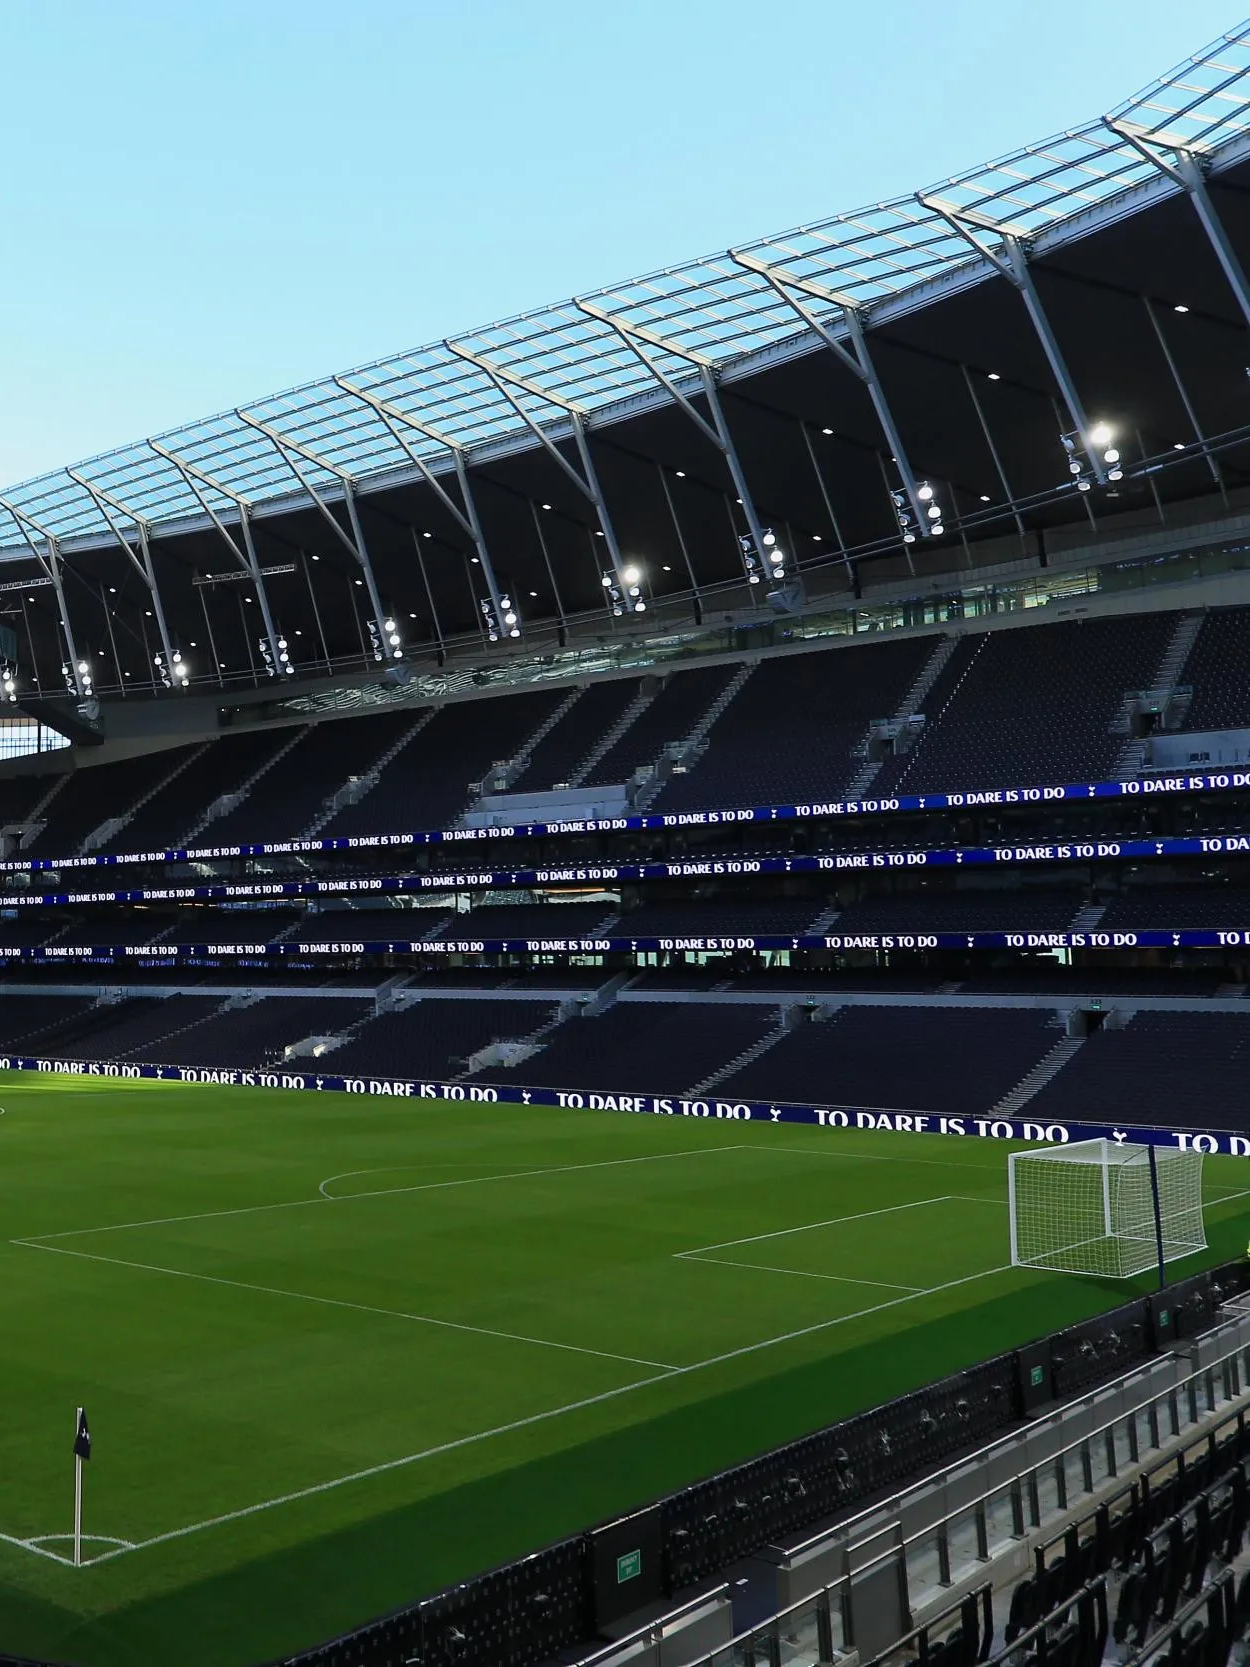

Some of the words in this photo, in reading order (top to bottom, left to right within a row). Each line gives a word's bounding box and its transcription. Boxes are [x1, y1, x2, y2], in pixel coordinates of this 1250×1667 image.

[1119, 781, 1140, 794] TO
[1143, 778, 1186, 793] DARE
[1189, 776, 1204, 790] IS
[1207, 774, 1229, 788] TO
[947, 794, 964, 805] TO
[966, 791, 1003, 804] DARE
[1005, 790, 1019, 802] IS
[1021, 789, 1041, 801] TO
[1043, 787, 1065, 799] DO
[795, 805, 811, 816] TO
[812, 803, 845, 815] DARE
[846, 802, 859, 813] IS
[860, 800, 878, 812] TO
[880, 799, 899, 810] DO
[546, 823, 559, 833] TO
[559, 821, 585, 833] DARE
[586, 821, 596, 831] IS
[597, 820, 611, 830] TO
[612, 819, 628, 829] DO
[263, 844, 273, 853] TO
[273, 843, 292, 852] DARE
[292, 842, 301, 851] IS
[300, 841, 311, 850] TO
[311, 841, 323, 850] DO
[994, 849, 1013, 860] TO
[1015, 847, 1054, 860] DARE
[1057, 846, 1071, 858] IS
[1074, 845, 1095, 857] TO
[1097, 844, 1121, 856] DO
[1199, 839, 1222, 852] TO
[818, 857, 834, 869] TO
[836, 855, 870, 868] DARE
[872, 855, 885, 866] IS
[887, 854, 905, 865] TO
[907, 853, 927, 865] DO
[536, 871, 549, 881] TO
[549, 870, 576, 881] DARE
[576, 869, 587, 880] IS
[587, 869, 601, 879] TO
[602, 868, 618, 878] DO
[143, 890, 152, 899] TO
[151, 890, 169, 899] DARE
[168, 889, 176, 898] IS
[175, 889, 185, 898] TO
[184, 889, 195, 897] DO
[825, 937, 842, 948] TO
[843, 936, 879, 948] DARE
[881, 936, 894, 947] IS
[896, 936, 915, 947] TO
[917, 936, 938, 947] DO
[1005, 934, 1025, 946] TO
[1027, 934, 1068, 946] DARE
[1071, 934, 1086, 946] IS
[1088, 933, 1110, 946] TO
[1113, 933, 1137, 946] DO
[1216, 931, 1240, 945] TO
[36, 1060, 52, 1073] TO
[54, 1061, 86, 1075] DARE
[88, 1063, 100, 1076] IS
[102, 1064, 119, 1077] TO
[121, 1065, 141, 1078] DO
[179, 1069, 198, 1083] TO
[200, 1070, 238, 1085] DARE
[241, 1073, 255, 1086] IS
[258, 1074, 279, 1088] TO
[282, 1075, 305, 1089] DO
[343, 1079, 366, 1094] TO
[369, 1081, 415, 1097] DARE
[420, 1084, 437, 1099] IS
[440, 1085, 465, 1100] TO
[469, 1087, 498, 1102] DO
[556, 1092, 584, 1109] TO
[589, 1094, 646, 1113] DARE
[653, 1098, 674, 1115] IS
[678, 1100, 710, 1117] TO
[716, 1103, 751, 1120] DO
[814, 1109, 849, 1127] TO
[856, 1112, 929, 1133] DARE
[939, 1117, 966, 1136] IS
[973, 1120, 1014, 1138] TO
[1023, 1123, 1069, 1142] DO
[1171, 1132, 1218, 1154] TO
